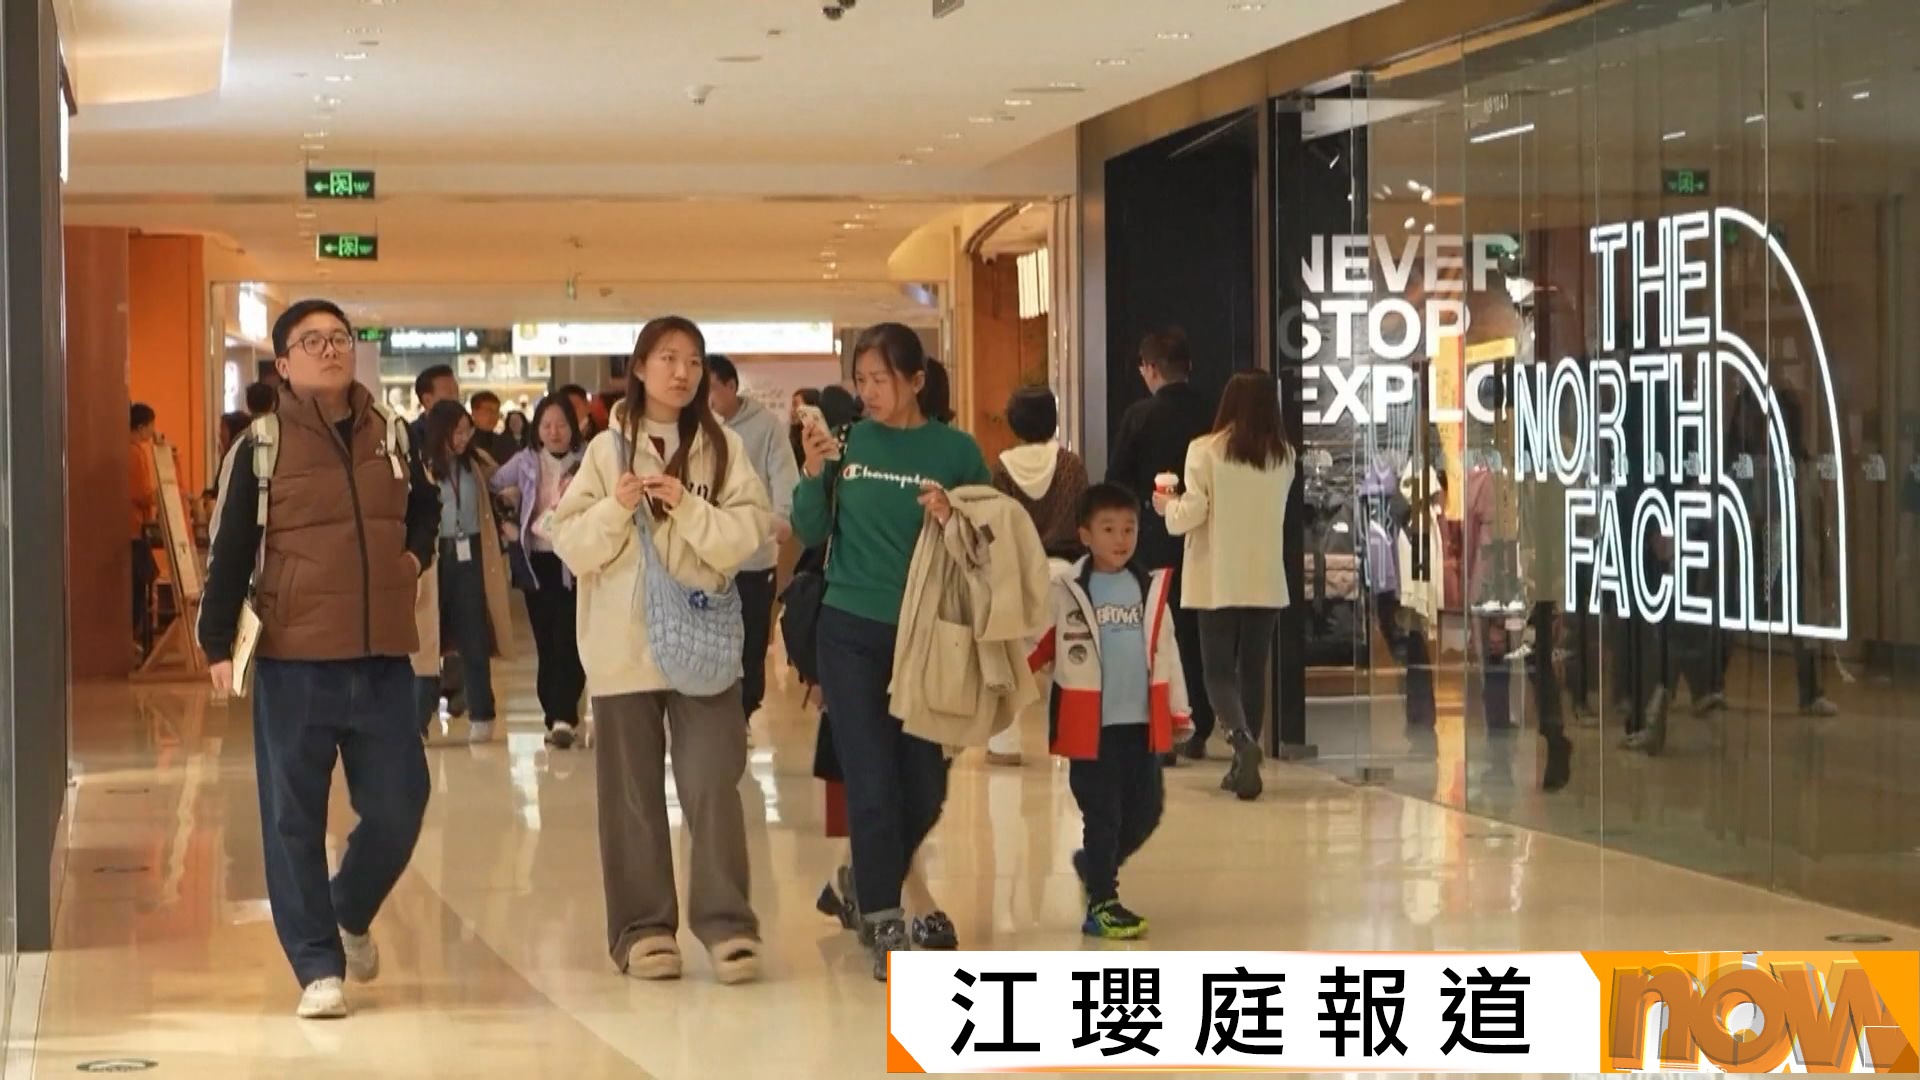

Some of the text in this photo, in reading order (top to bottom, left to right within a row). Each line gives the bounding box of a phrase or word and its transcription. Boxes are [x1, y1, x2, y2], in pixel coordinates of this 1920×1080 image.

[1283, 298, 1471, 359] STOP
[1590, 211, 1710, 350] THE
[1514, 351, 1711, 484] NORTH
[1565, 491, 1712, 624] FACE
